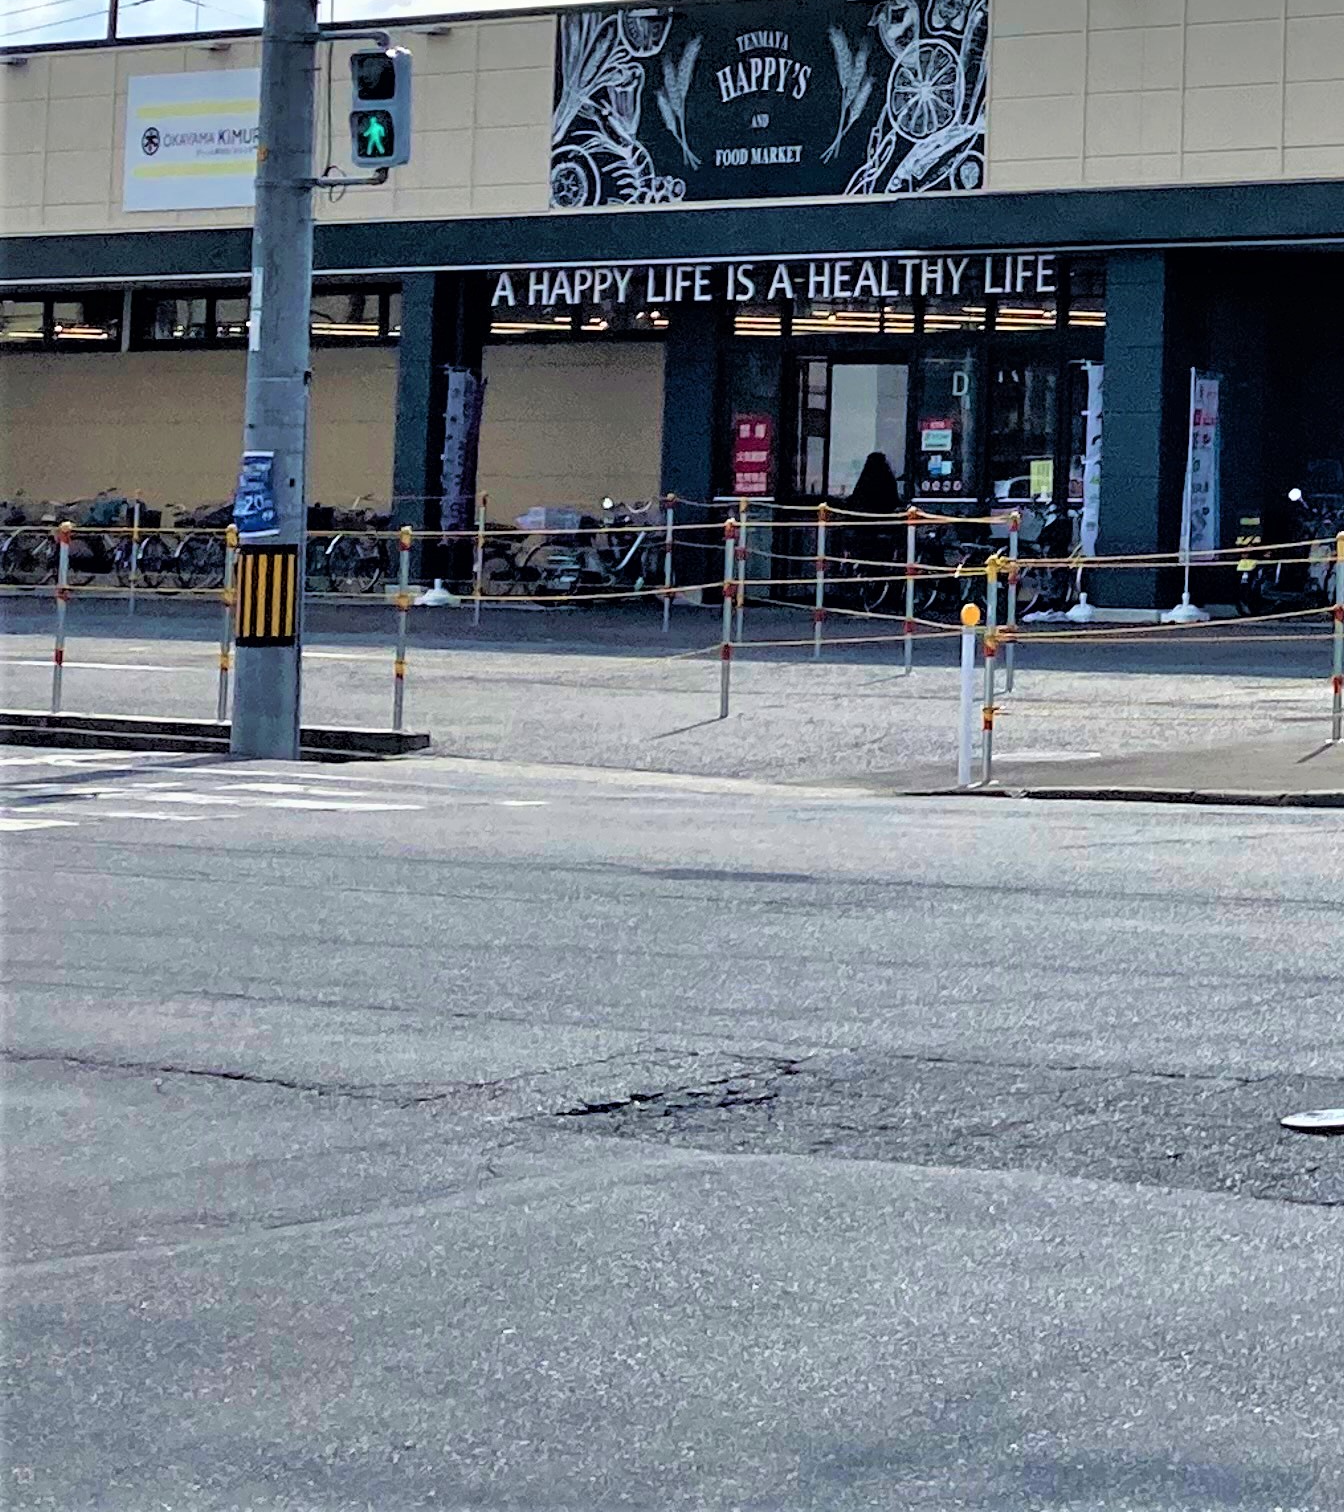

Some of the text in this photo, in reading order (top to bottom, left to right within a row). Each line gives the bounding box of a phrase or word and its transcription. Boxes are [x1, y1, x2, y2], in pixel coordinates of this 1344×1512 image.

[736, 30, 789, 54] TENMAYA
[716, 57, 812, 102] HAPPY'S
[751, 113, 769, 128] AND
[218, 128, 261, 145] KIMUR
[715, 145, 803, 167] FOOD MARKET
[491, 255, 1057, 307] A HAPPY LIFE IS A HEALTHY LIFE
